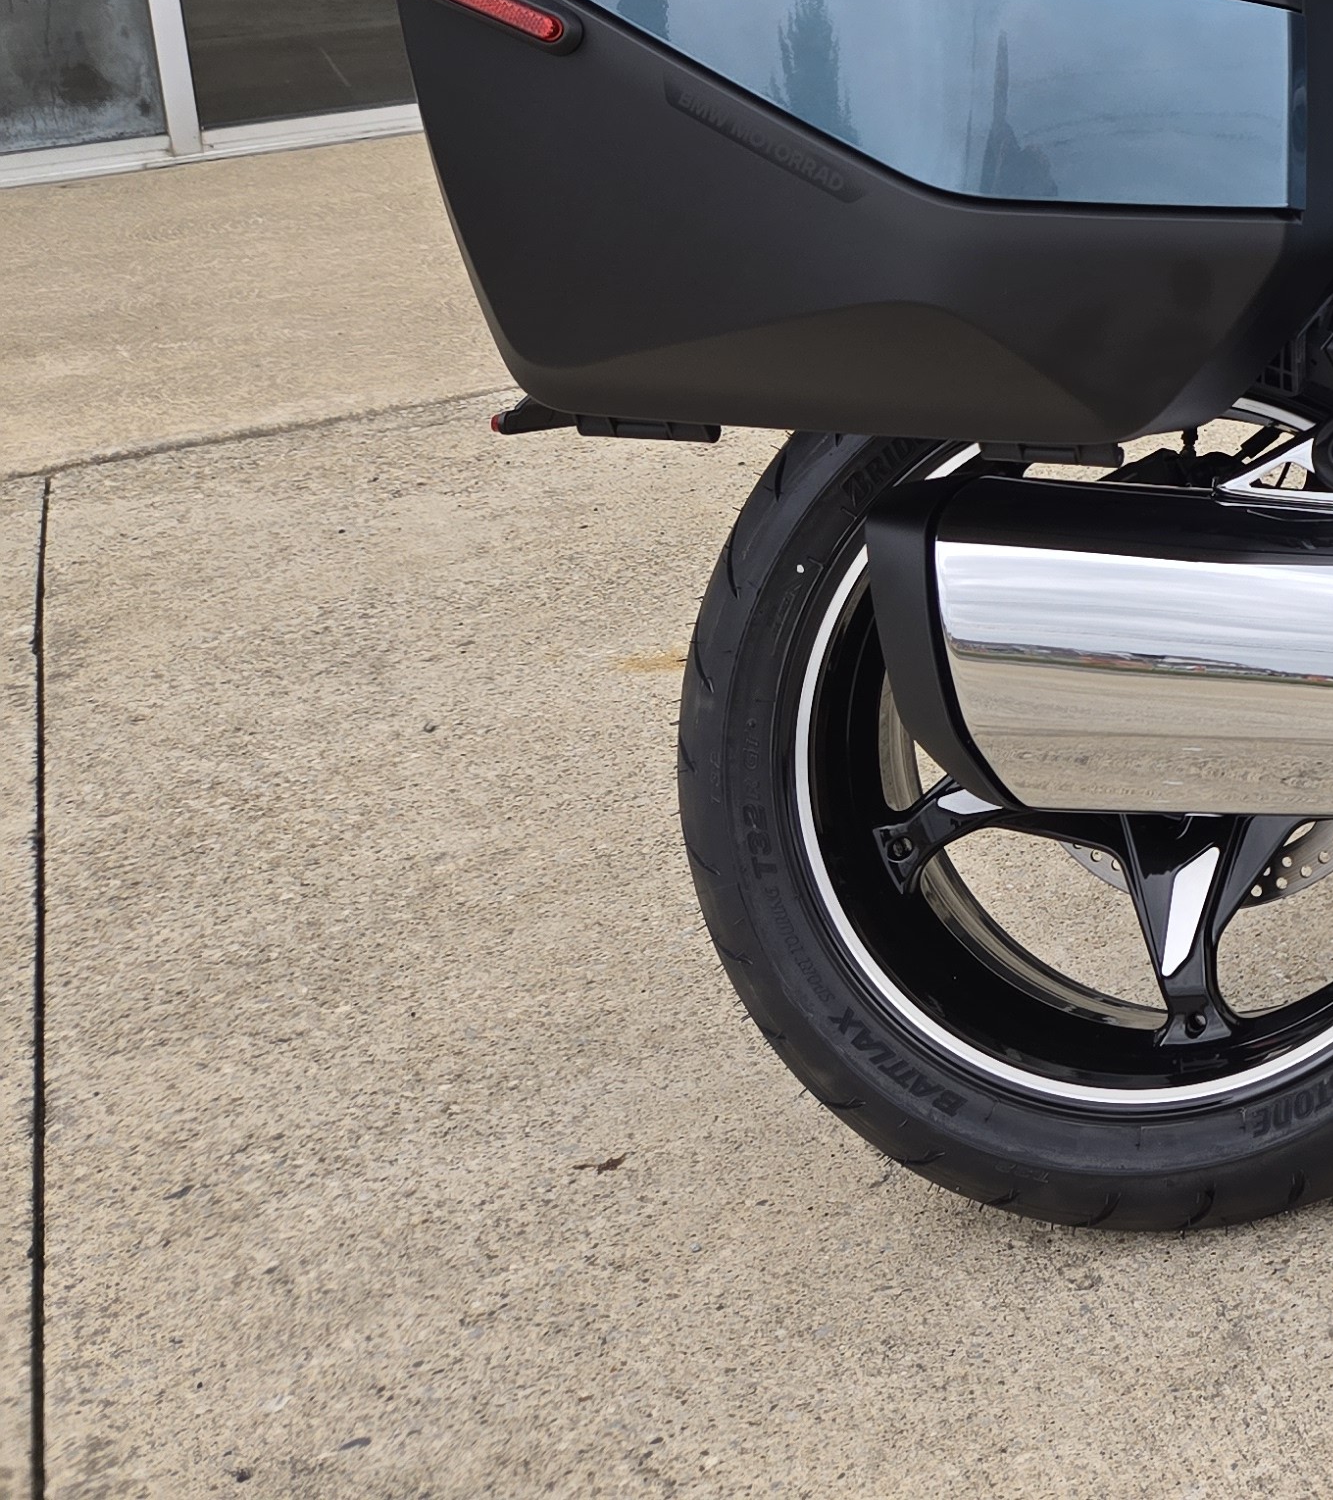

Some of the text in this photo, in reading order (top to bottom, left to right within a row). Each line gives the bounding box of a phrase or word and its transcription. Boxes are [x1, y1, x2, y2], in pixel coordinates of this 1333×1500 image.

[678, 92, 844, 191] BMW MOTORRAD
[828, 1006, 968, 1118] BATTLAX
